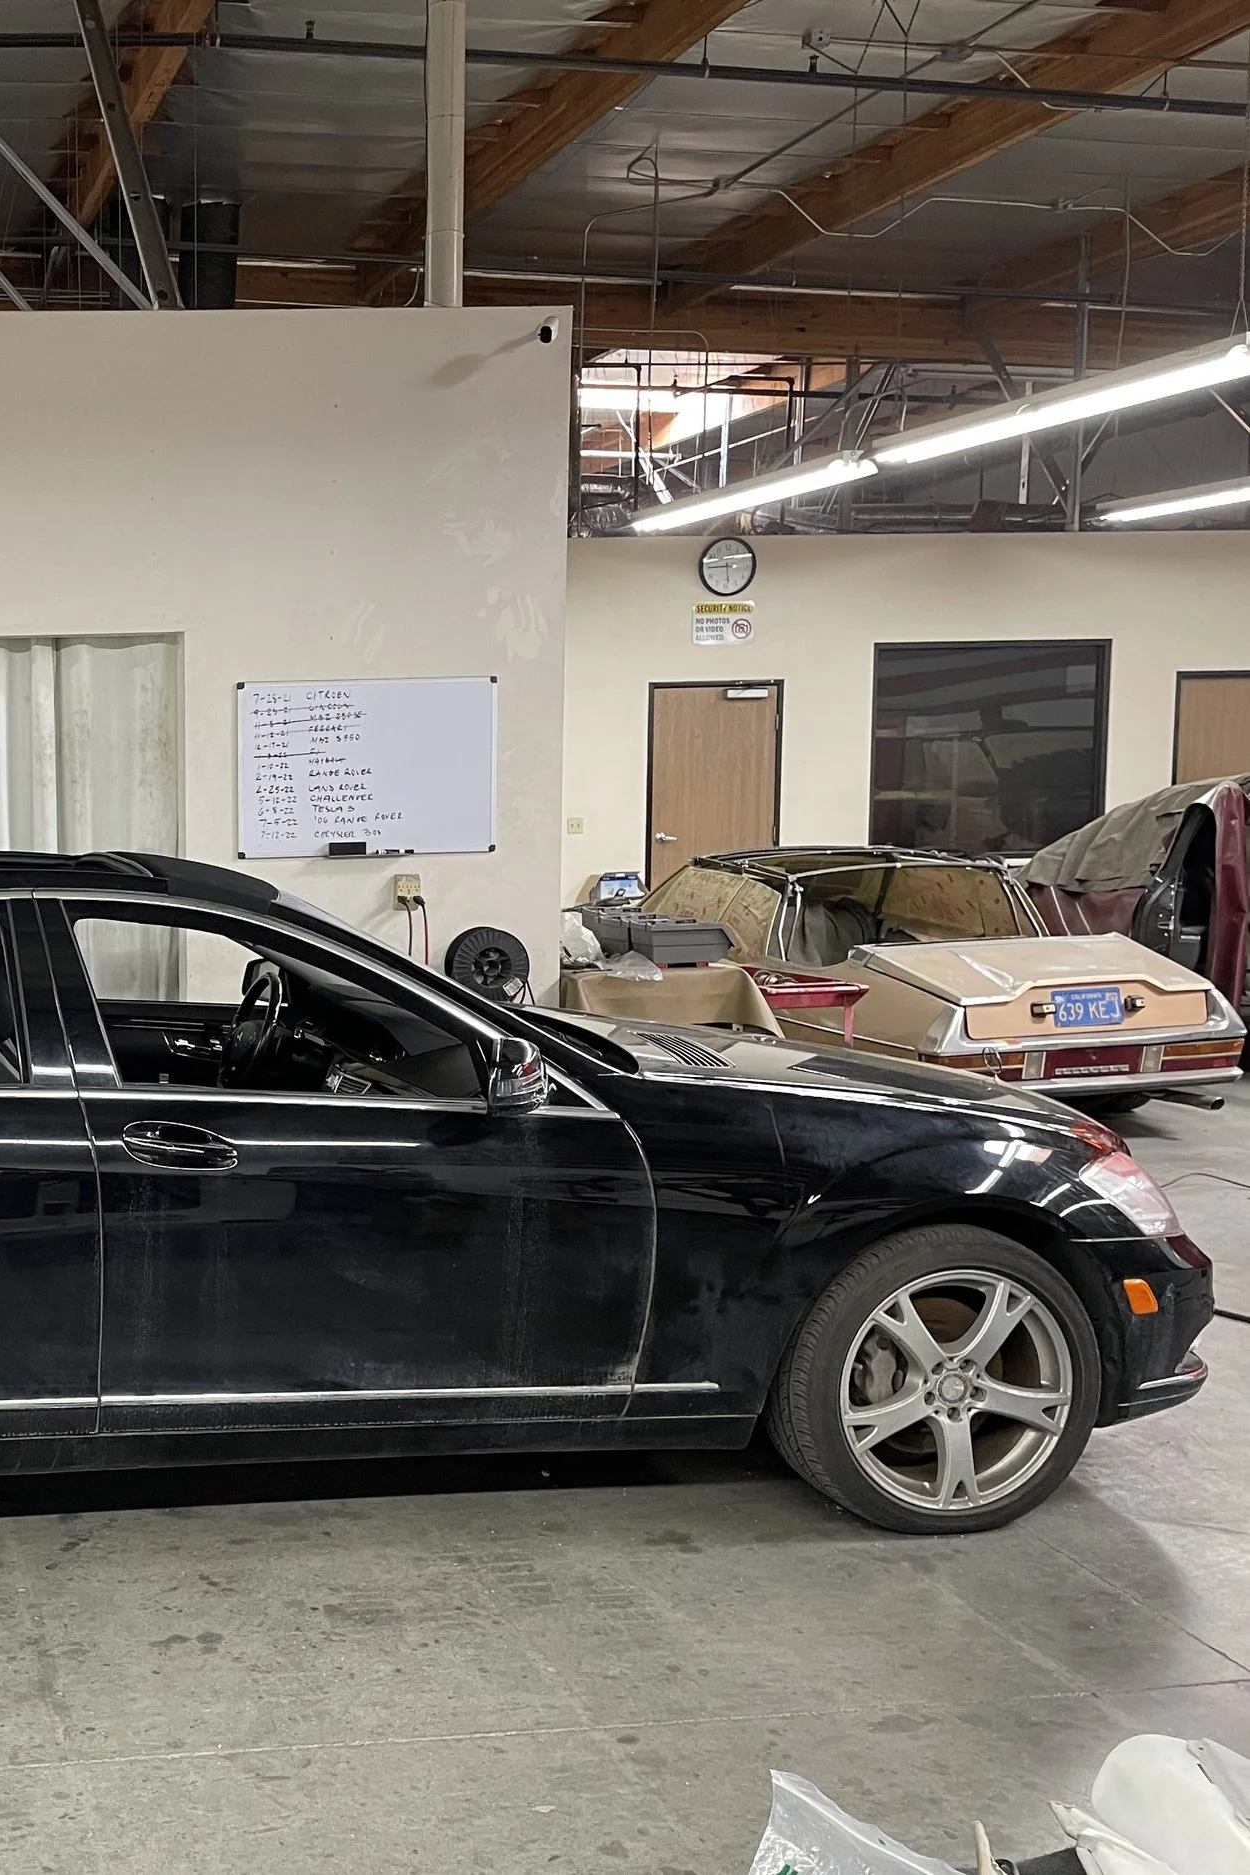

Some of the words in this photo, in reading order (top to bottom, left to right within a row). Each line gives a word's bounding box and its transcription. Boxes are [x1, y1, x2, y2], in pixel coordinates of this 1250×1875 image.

[696, 604, 727, 613] SECURITY
[729, 604, 751, 613] NOTICE
[705, 625, 724, 633] VIDEO
[306, 690, 351, 700] CITROEN
[344, 767, 372, 777] ROVER
[255, 784, 294, 794] 2-25-22
[308, 784, 335, 793] LAND
[339, 782, 367, 791] ROVER
[312, 804, 343, 813] TESLA
[374, 811, 403, 821] ROVER
[1058, 1002, 1084, 1022] 639
[1088, 999, 1120, 1019] KEJ
